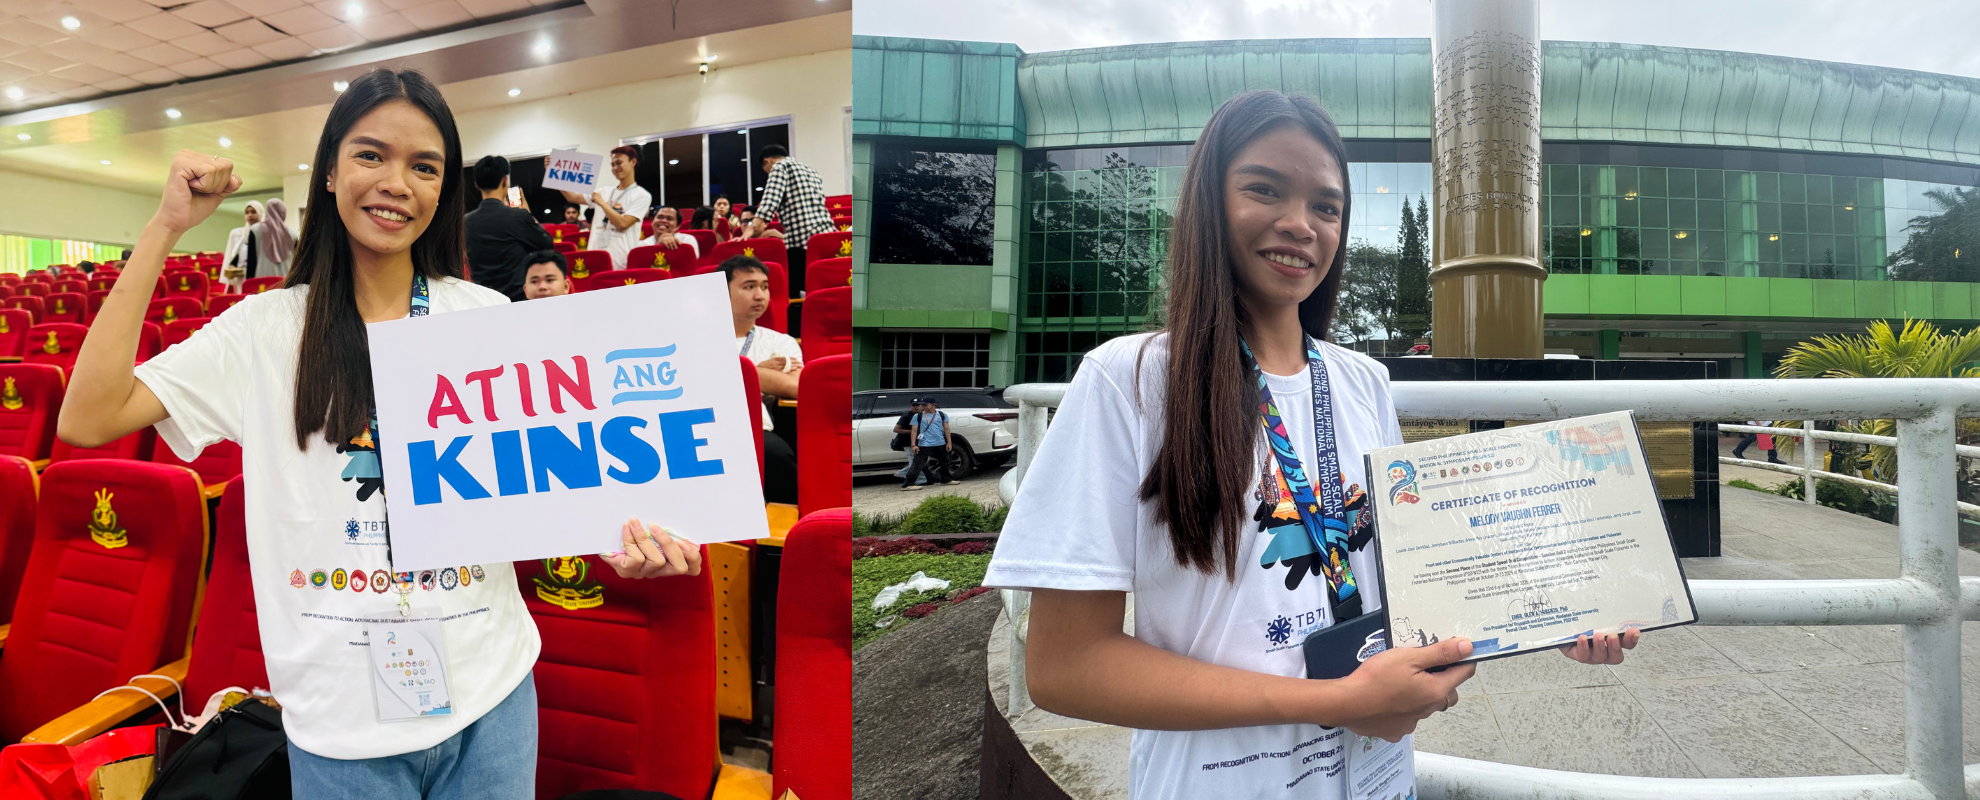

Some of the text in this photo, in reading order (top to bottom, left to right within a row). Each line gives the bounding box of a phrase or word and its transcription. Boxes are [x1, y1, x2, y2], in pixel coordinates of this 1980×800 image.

[548, 168, 595, 186] KINSE
[555, 159, 581, 171] ATIN
[1446, 191, 1483, 208] ANDRES
[1486, 190, 1534, 206] BONIFACIO
[427, 355, 677, 429] ATIN ANG
[1311, 361, 1334, 516] FISHERIES NATIONAL SYMPOSIUM
[1317, 361, 1344, 519] SECOND PHILIPPINES SMALL-SCALE
[407, 407, 725, 506] KINSE
[1430, 477, 1596, 511] CERTIFICATE OF RECOGNITION
[362, 521, 387, 531] TBT
[1469, 502, 1561, 527] MELODY VAUGHN FERRER
[1296, 607, 1325, 627] TBTI
[1202, 762, 1219, 771] FROM
[1220, 753, 1259, 768] RECOGNITION
[1270, 750, 1291, 759] ACTION:
[1292, 736, 1324, 754] ADVANCING
[1302, 750, 1335, 765] OCTOBER
[1286, 769, 1313, 789] MINDANAO
[1314, 765, 1330, 773] STATE
